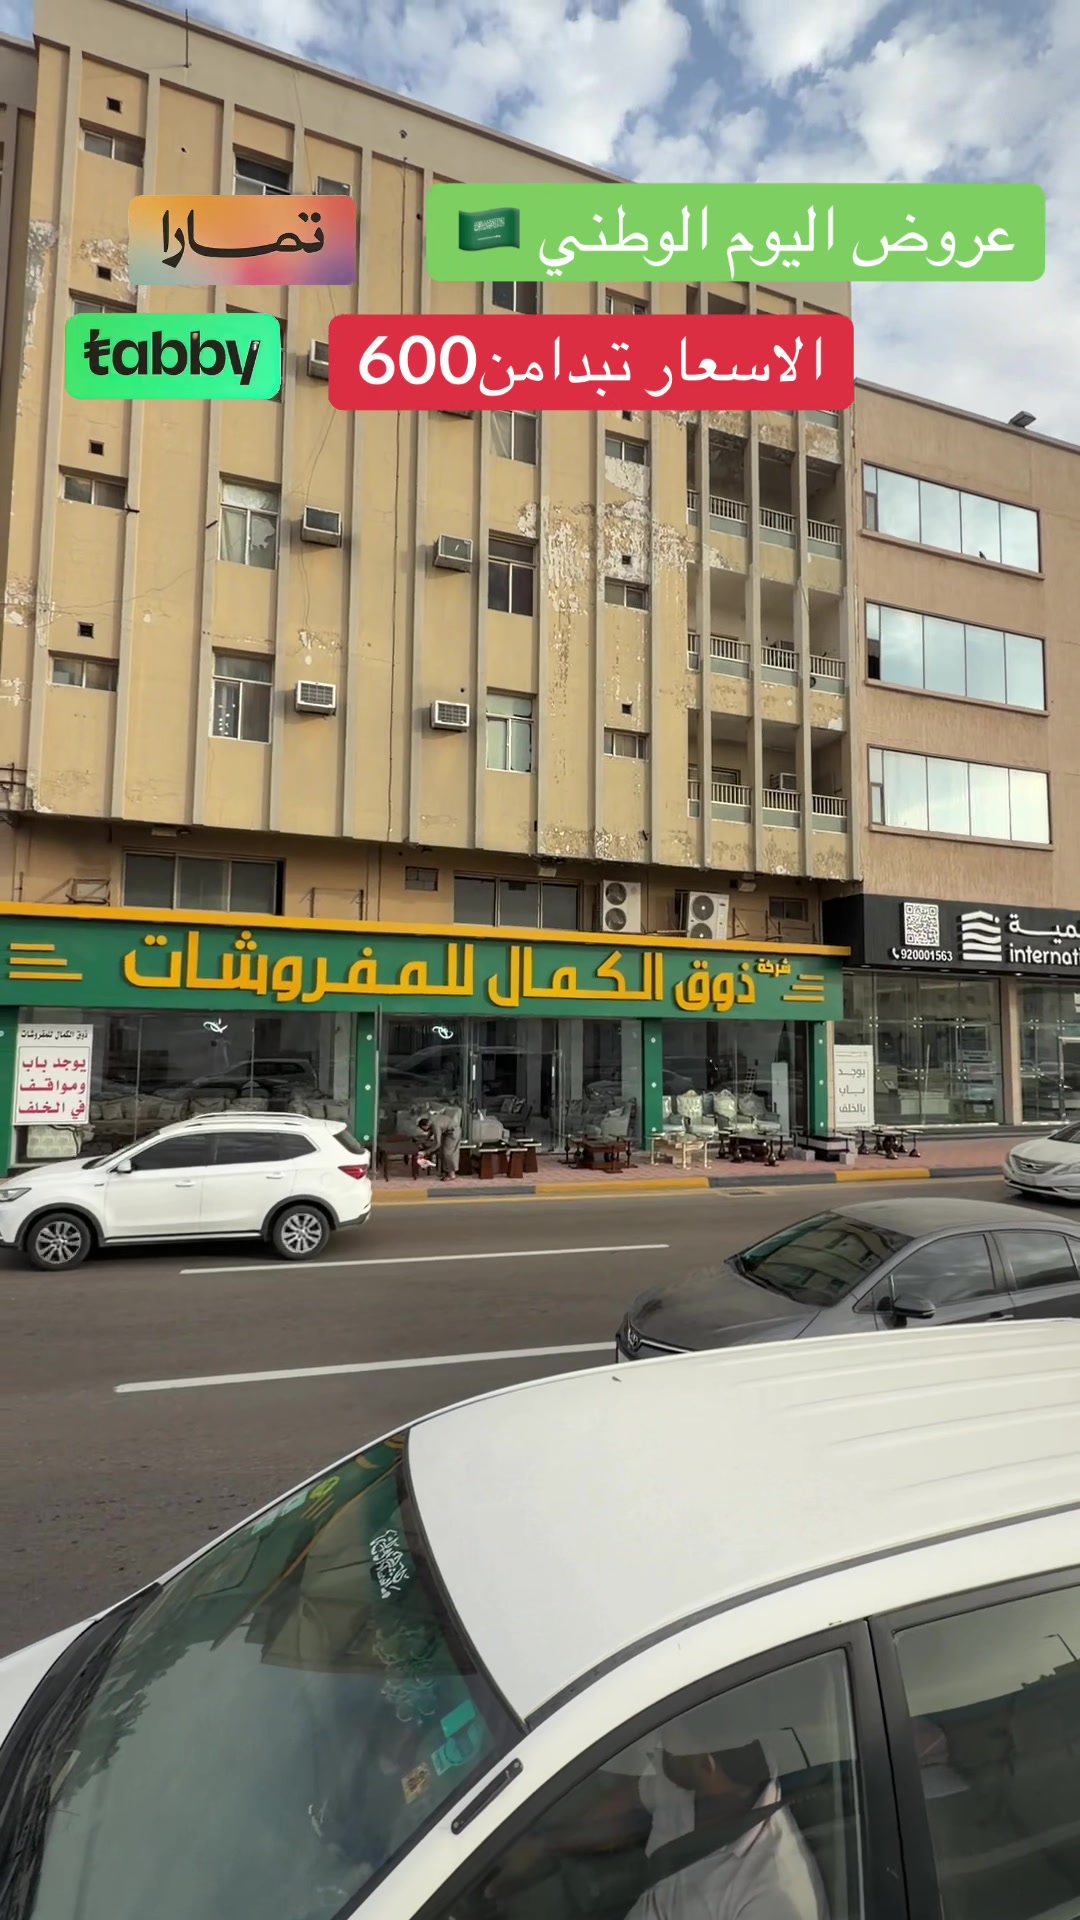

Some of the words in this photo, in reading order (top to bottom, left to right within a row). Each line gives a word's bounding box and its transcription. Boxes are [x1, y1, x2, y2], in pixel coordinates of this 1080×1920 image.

[1008, 913, 1080, 944] مية
[900, 948, 953, 962] 920001563
[1009, 943, 1080, 966] internat
[123, 930, 474, 1003] للمفروشات
[757, 957, 792, 978] شركة
[488, 945, 664, 1008] الكمال
[675, 960, 755, 1012] ذوق
[22, 1056, 48, 1073] باب
[53, 1057, 86, 1072] يوجد
[838, 1068, 866, 1079] يوجد
[20, 1078, 86, 1095] ومواقف
[839, 1084, 866, 1097] باب
[18, 1101, 65, 1115] الخلف
[71, 1100, 85, 1119] في
[839, 1103, 866, 1115] بالخلف
